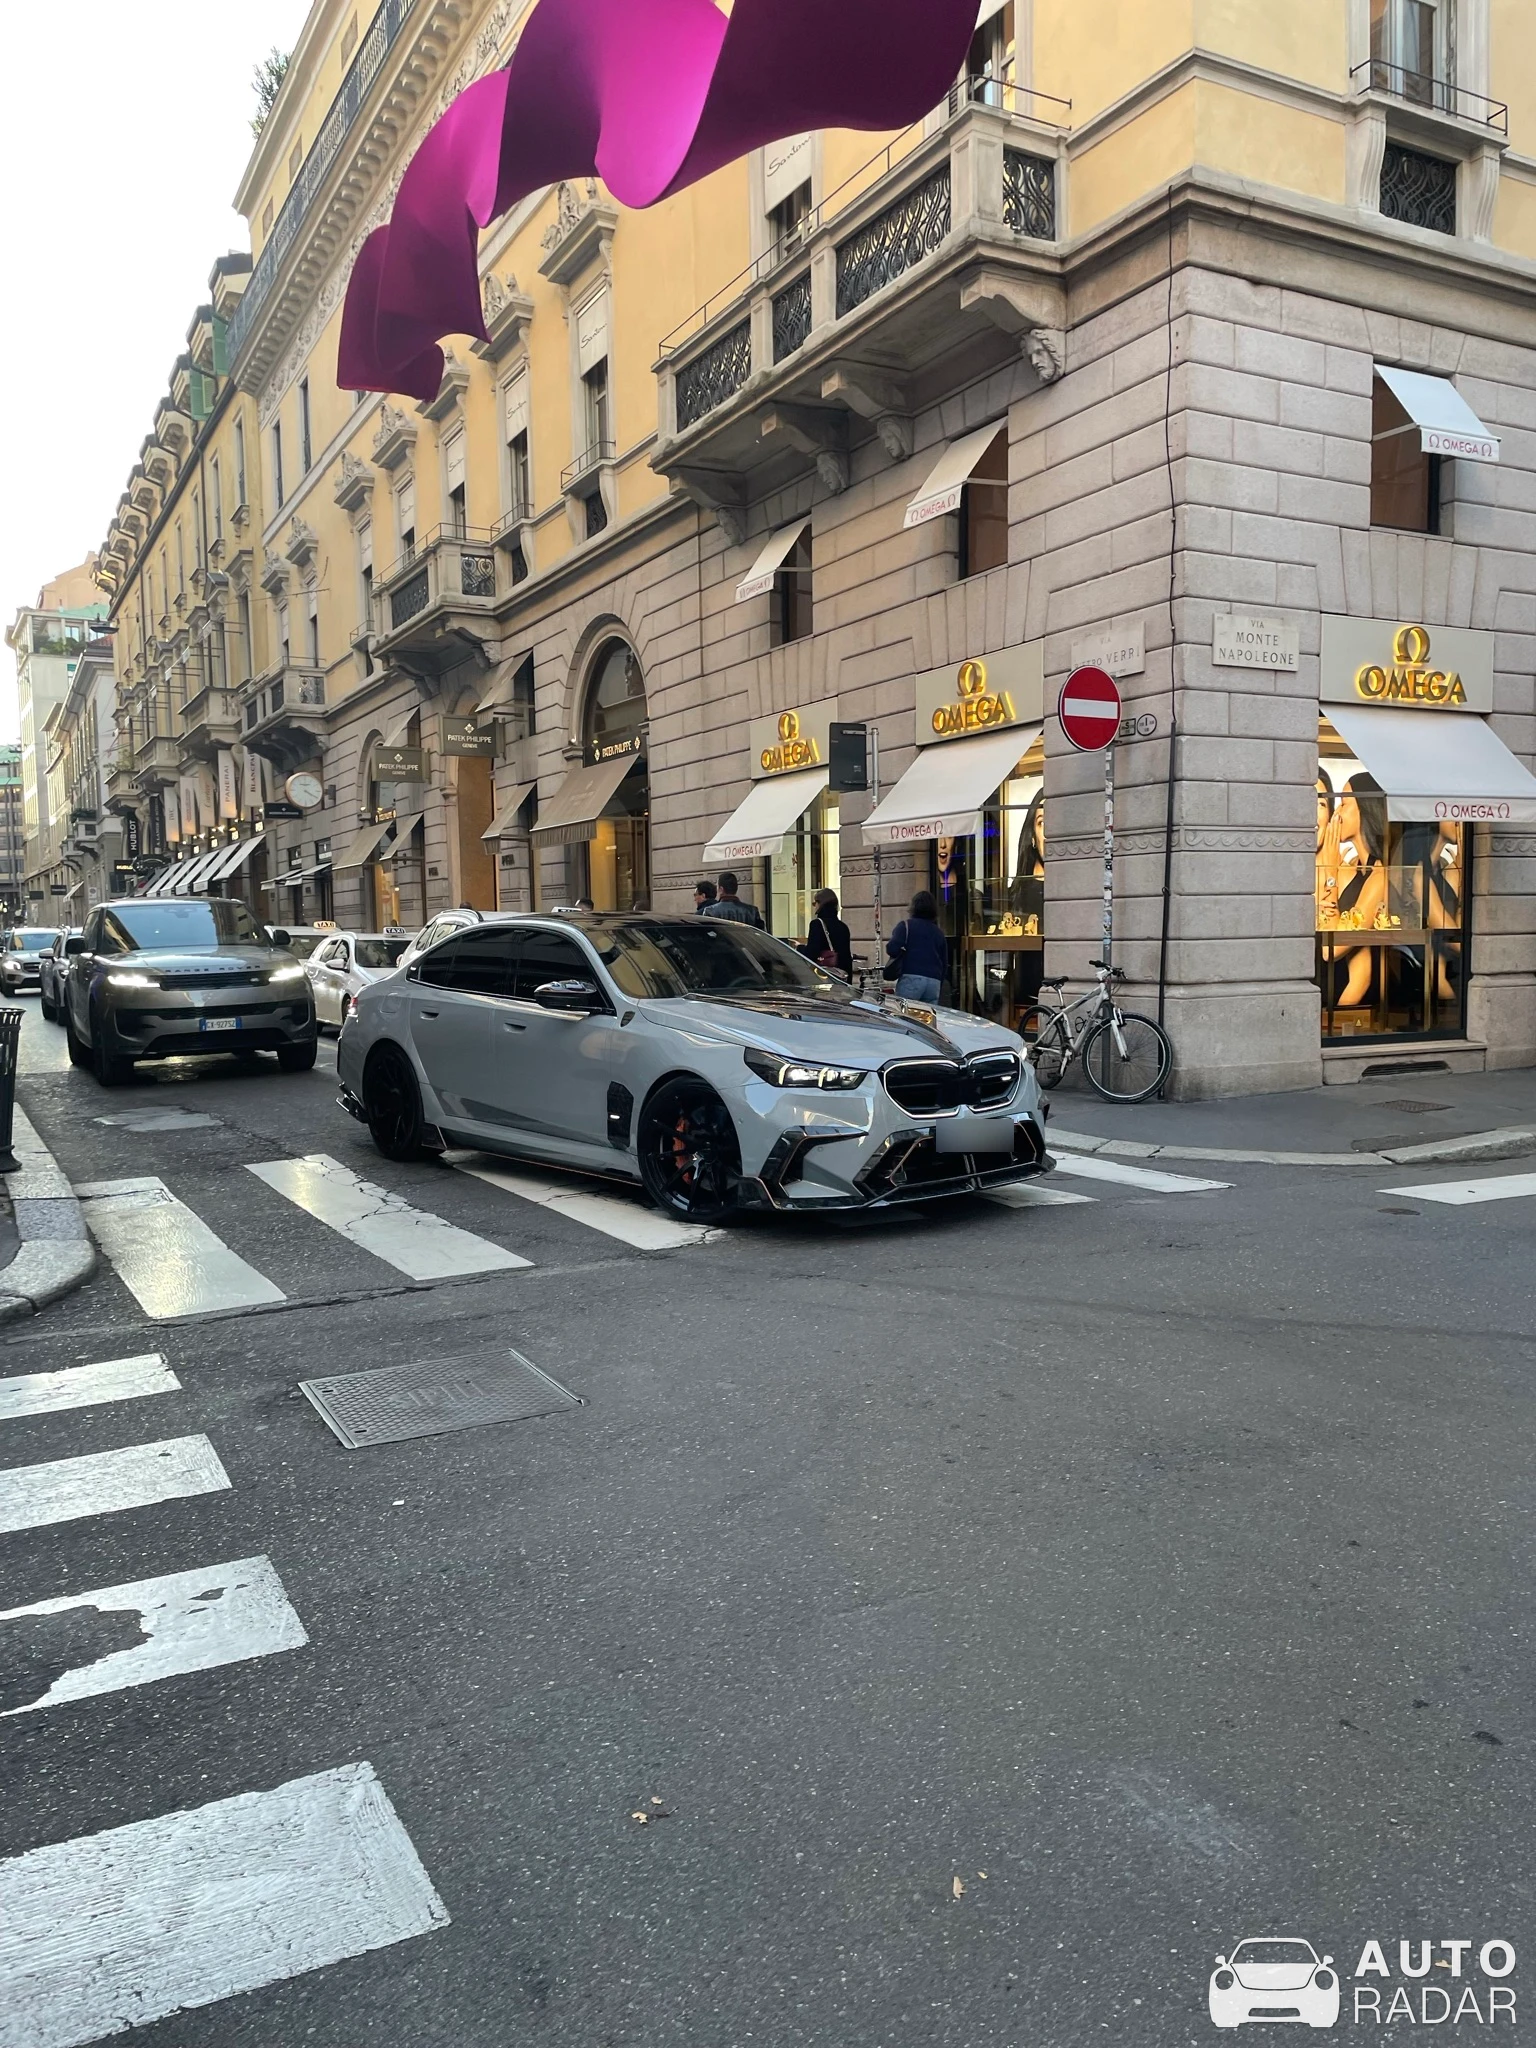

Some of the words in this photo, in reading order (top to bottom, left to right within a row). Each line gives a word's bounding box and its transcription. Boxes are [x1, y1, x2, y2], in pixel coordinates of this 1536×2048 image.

[1443, 438, 1479, 454] OMEGA
[920, 501, 946, 518] OMEGA
[1251, 619, 1265, 628] VIA
[1100, 637, 1112, 645] VIA
[1235, 631, 1279, 646] MONTE
[1218, 647, 1295, 665] NAPOLEONE
[1357, 665, 1468, 704] OMEGA
[932, 691, 1015, 735] OMEGA
[447, 734, 466, 742] PATEK
[466, 735, 492, 744] PHILIPPE
[761, 738, 820, 772] OMEGA
[395, 763, 419, 771] PHILIPPE
[223, 765, 231, 803] PANERAI
[1450, 804, 1495, 818] OMEGA
[129, 819, 137, 851] HUBLOT
[901, 824, 931, 839] OMEGA
[732, 845, 754, 857] OMEGA
